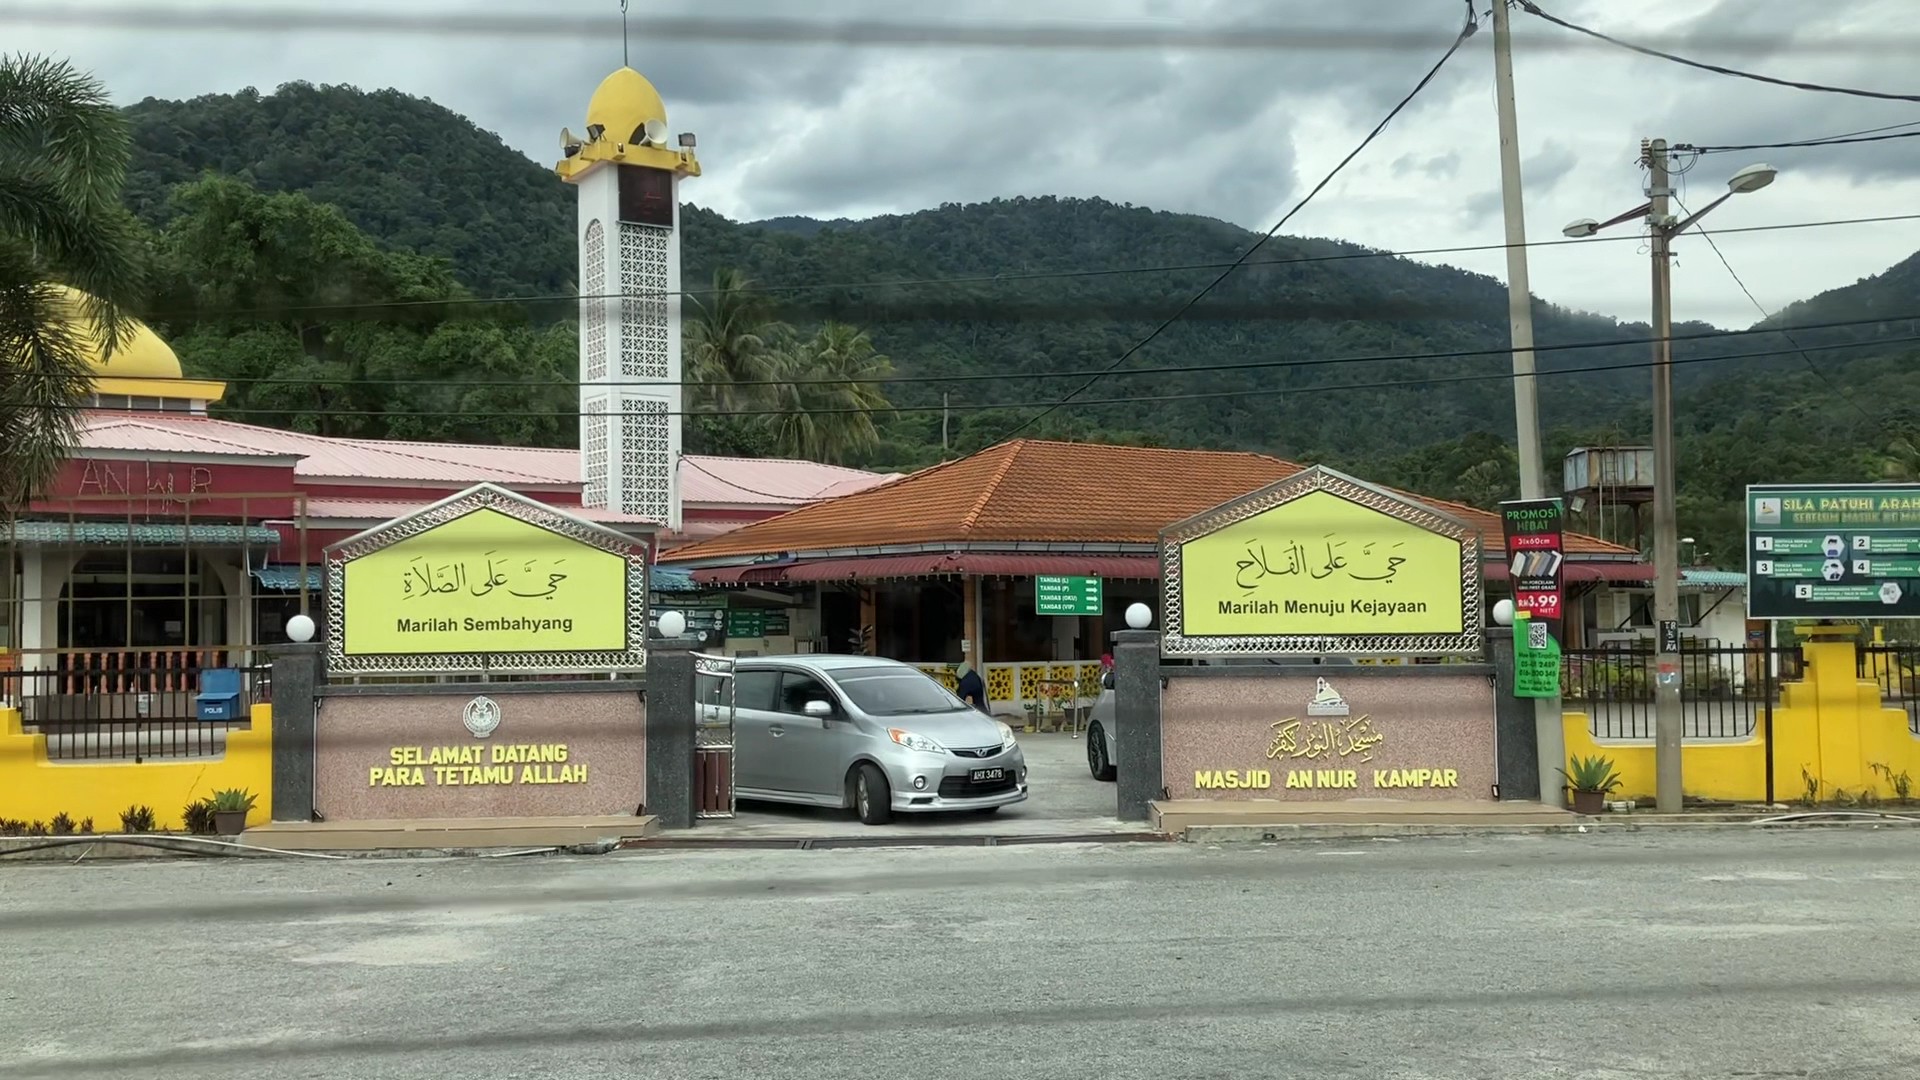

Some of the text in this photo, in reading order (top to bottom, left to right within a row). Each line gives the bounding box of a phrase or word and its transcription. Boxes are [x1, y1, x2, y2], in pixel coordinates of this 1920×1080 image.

[1784, 498, 1815, 510] SILA
[1821, 498, 1873, 510] PATUHI
[1506, 509, 1557, 520] PROMOSI
[1517, 521, 1548, 531] HEBAT
[1762, 540, 1767, 548] 1
[1858, 539, 1865, 547] 2
[1761, 563, 1768, 572] 3
[1858, 563, 1865, 571] 4
[1801, 588, 1807, 596] 5
[1218, 599, 1427, 616] Marilah Menuju Kejayaan
[397, 617, 572, 634] Marilah Sembahyang
[390, 745, 568, 765] SELAMAT DATANG
[369, 764, 588, 786] PARA TETAMU ALLAH
[986, 769, 1003, 779] 3478
[1195, 769, 1459, 789] MASJID AN NUR KAMPAR
